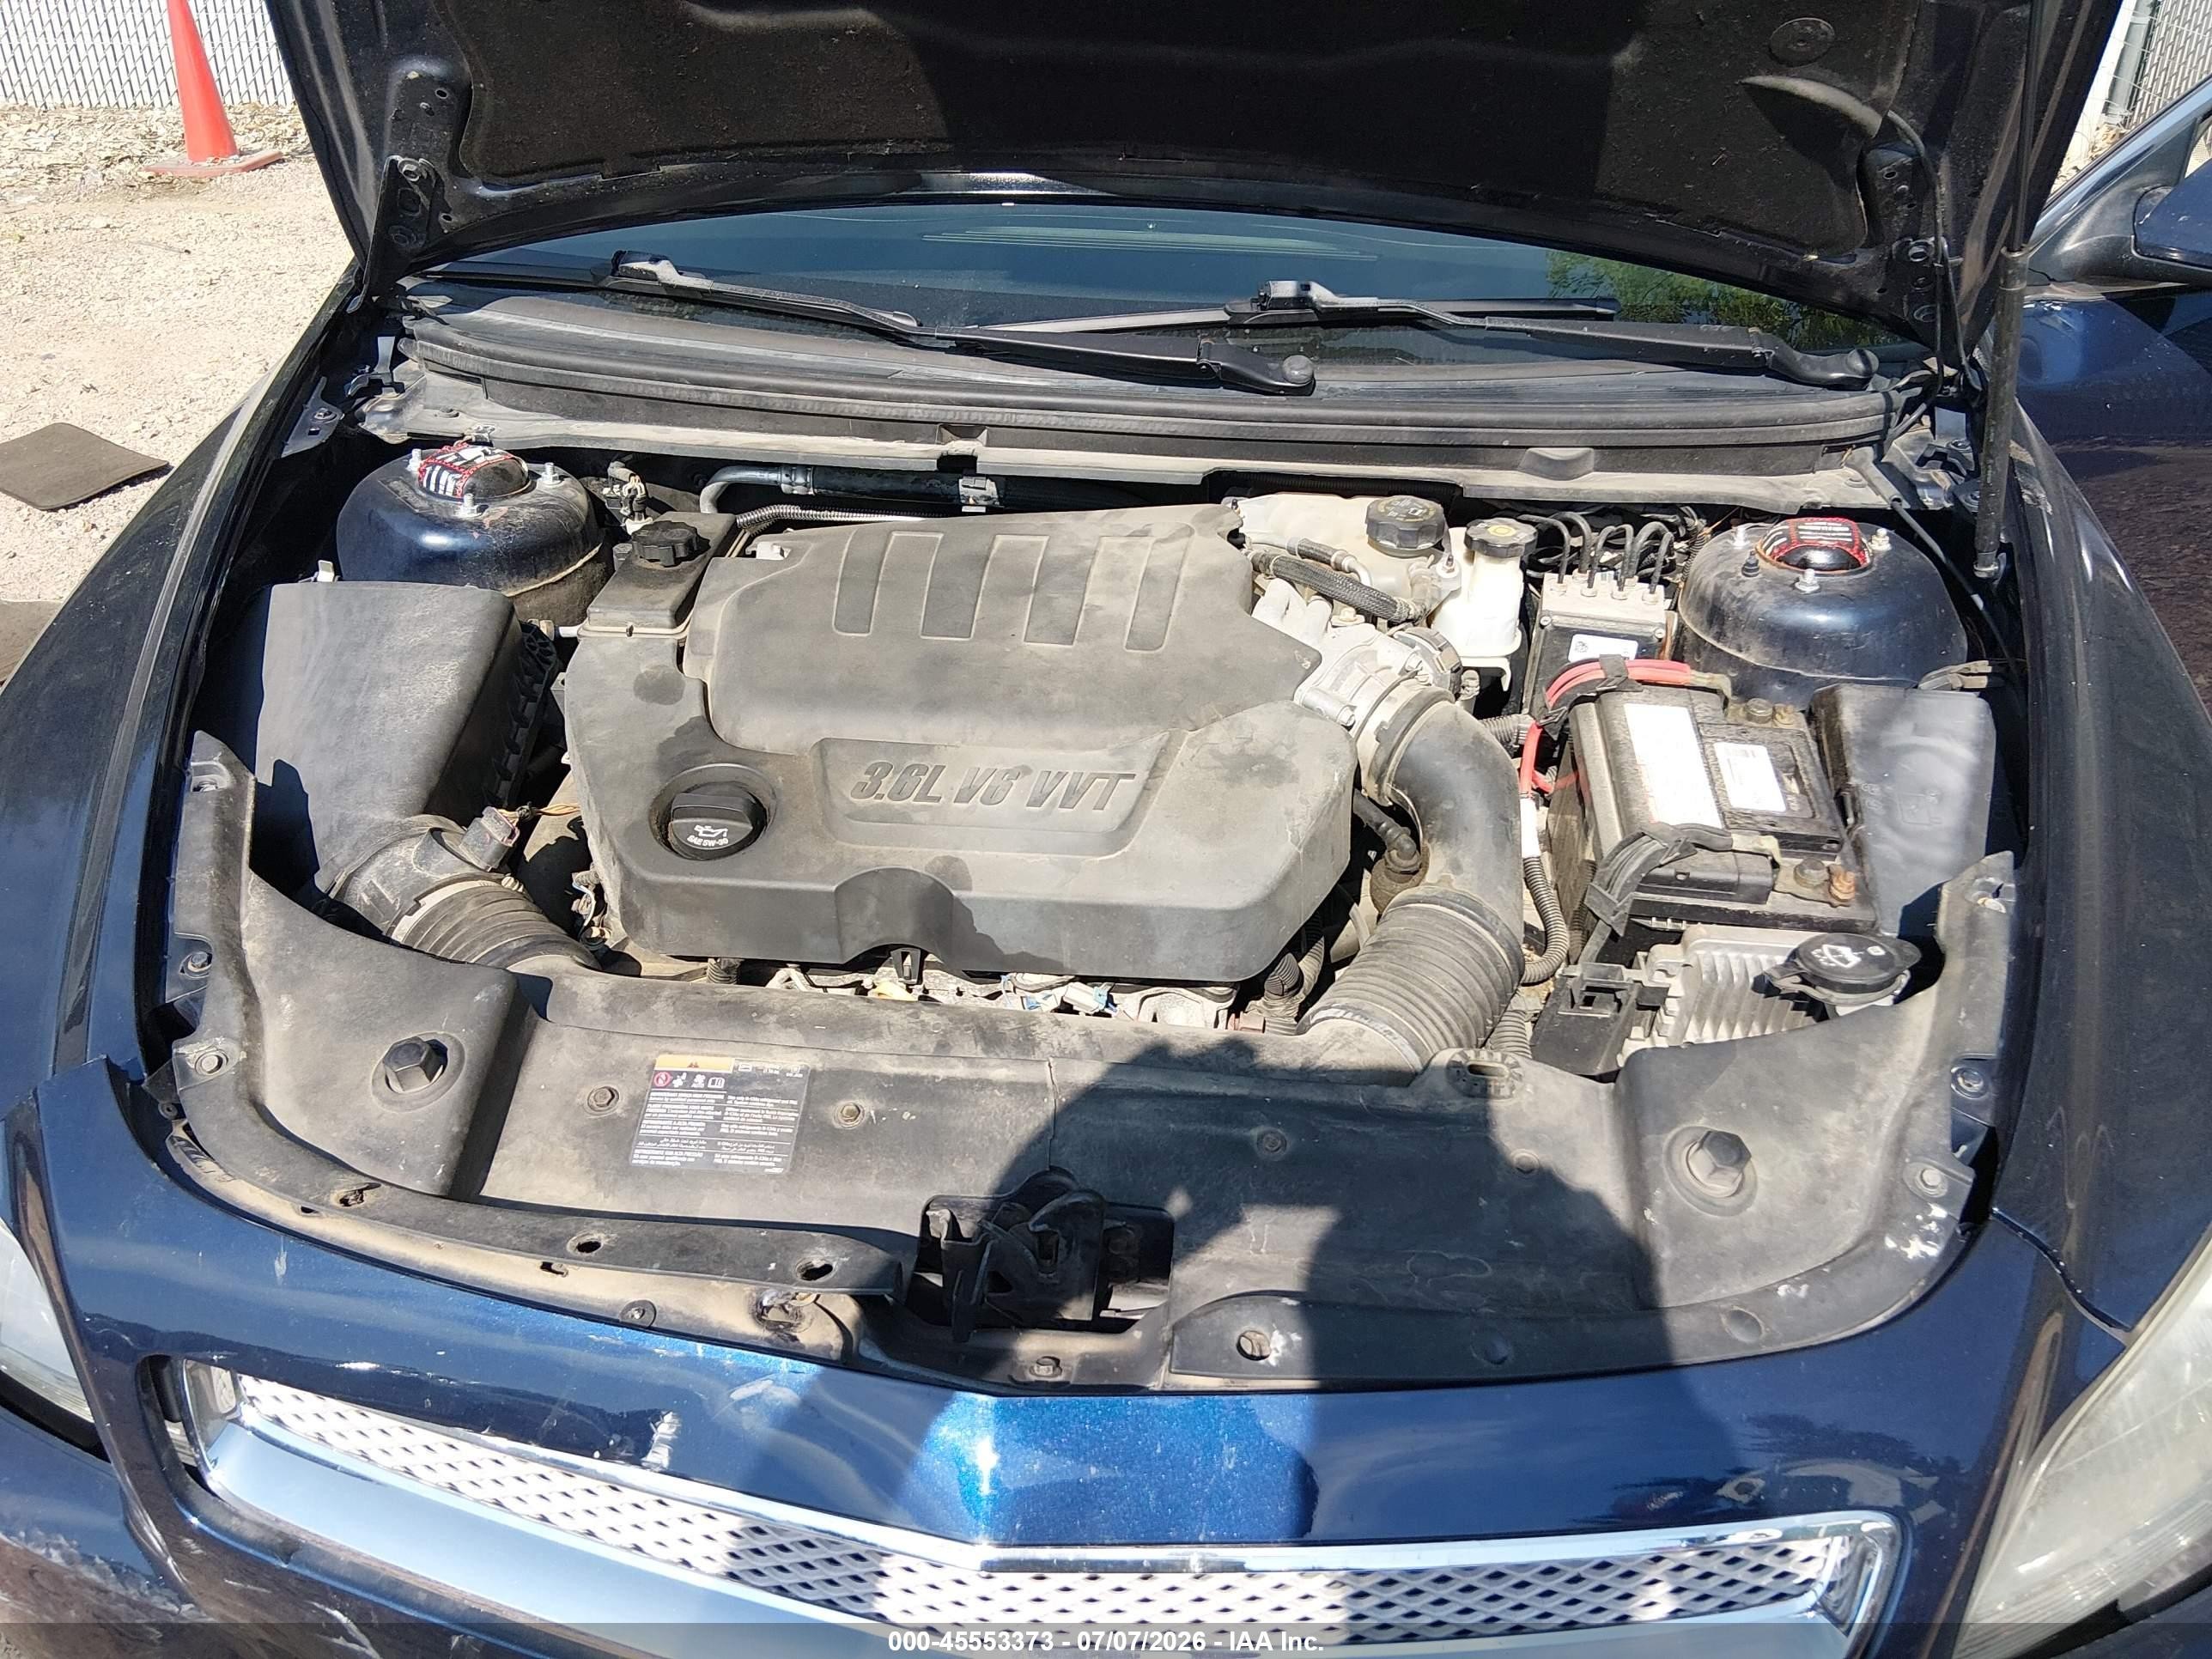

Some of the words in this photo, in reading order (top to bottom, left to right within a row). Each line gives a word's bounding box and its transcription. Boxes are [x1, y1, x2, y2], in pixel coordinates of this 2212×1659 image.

[850, 762, 945, 803] 3.6L
[953, 768, 1021, 805] V6
[1025, 770, 1136, 811] VVT
[686, 835, 702, 846] SAE
[702, 837, 729, 847] 5W-30
